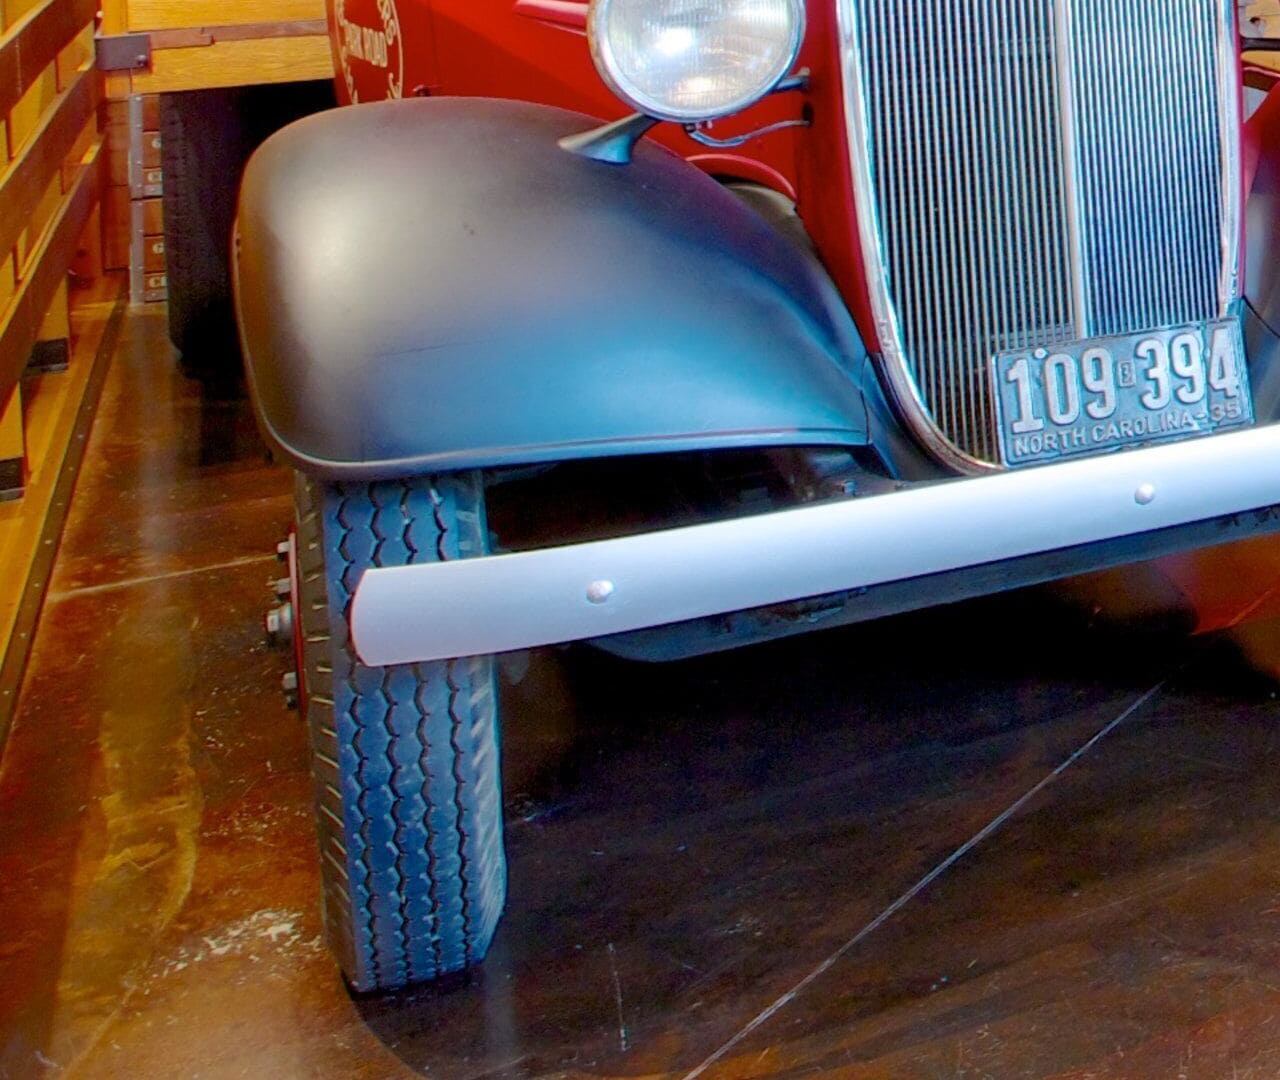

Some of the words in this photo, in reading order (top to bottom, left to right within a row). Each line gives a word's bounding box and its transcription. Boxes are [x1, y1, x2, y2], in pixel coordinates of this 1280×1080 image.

[1007, 347, 1117, 433] 109
[1137, 328, 1238, 410] 394
[1014, 426, 1087, 456] NORTH
